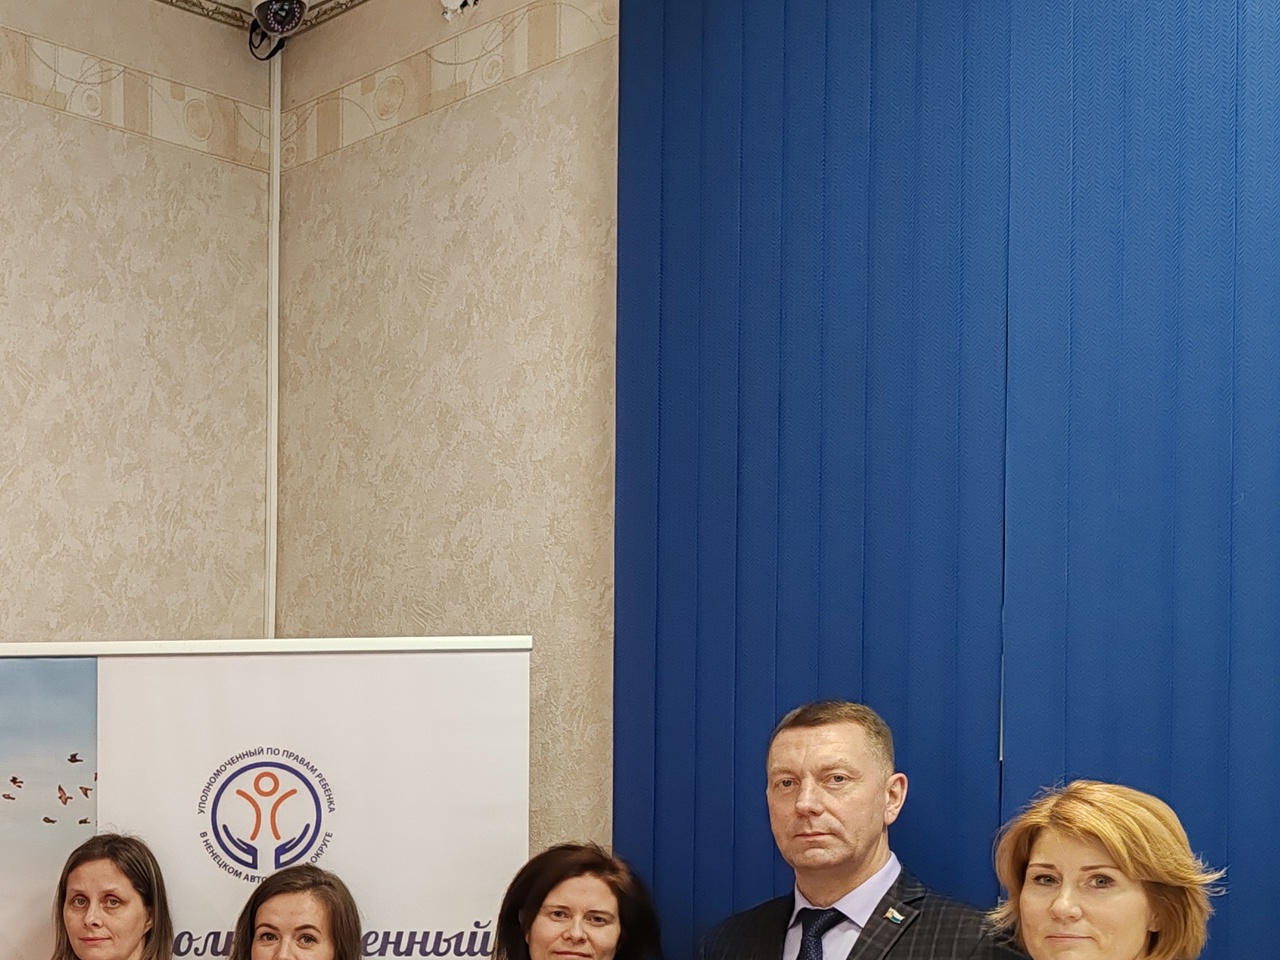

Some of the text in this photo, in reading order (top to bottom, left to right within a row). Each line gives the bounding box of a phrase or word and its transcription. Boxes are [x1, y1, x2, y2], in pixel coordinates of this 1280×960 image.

[197, 746, 336, 815] УПОЛНОМОЧЕННЫЙ ПО ПРАВАМ РЕБЕНКА
[199, 831, 208, 839] В
[202, 840, 243, 879] НЕНЕЦКОМ
